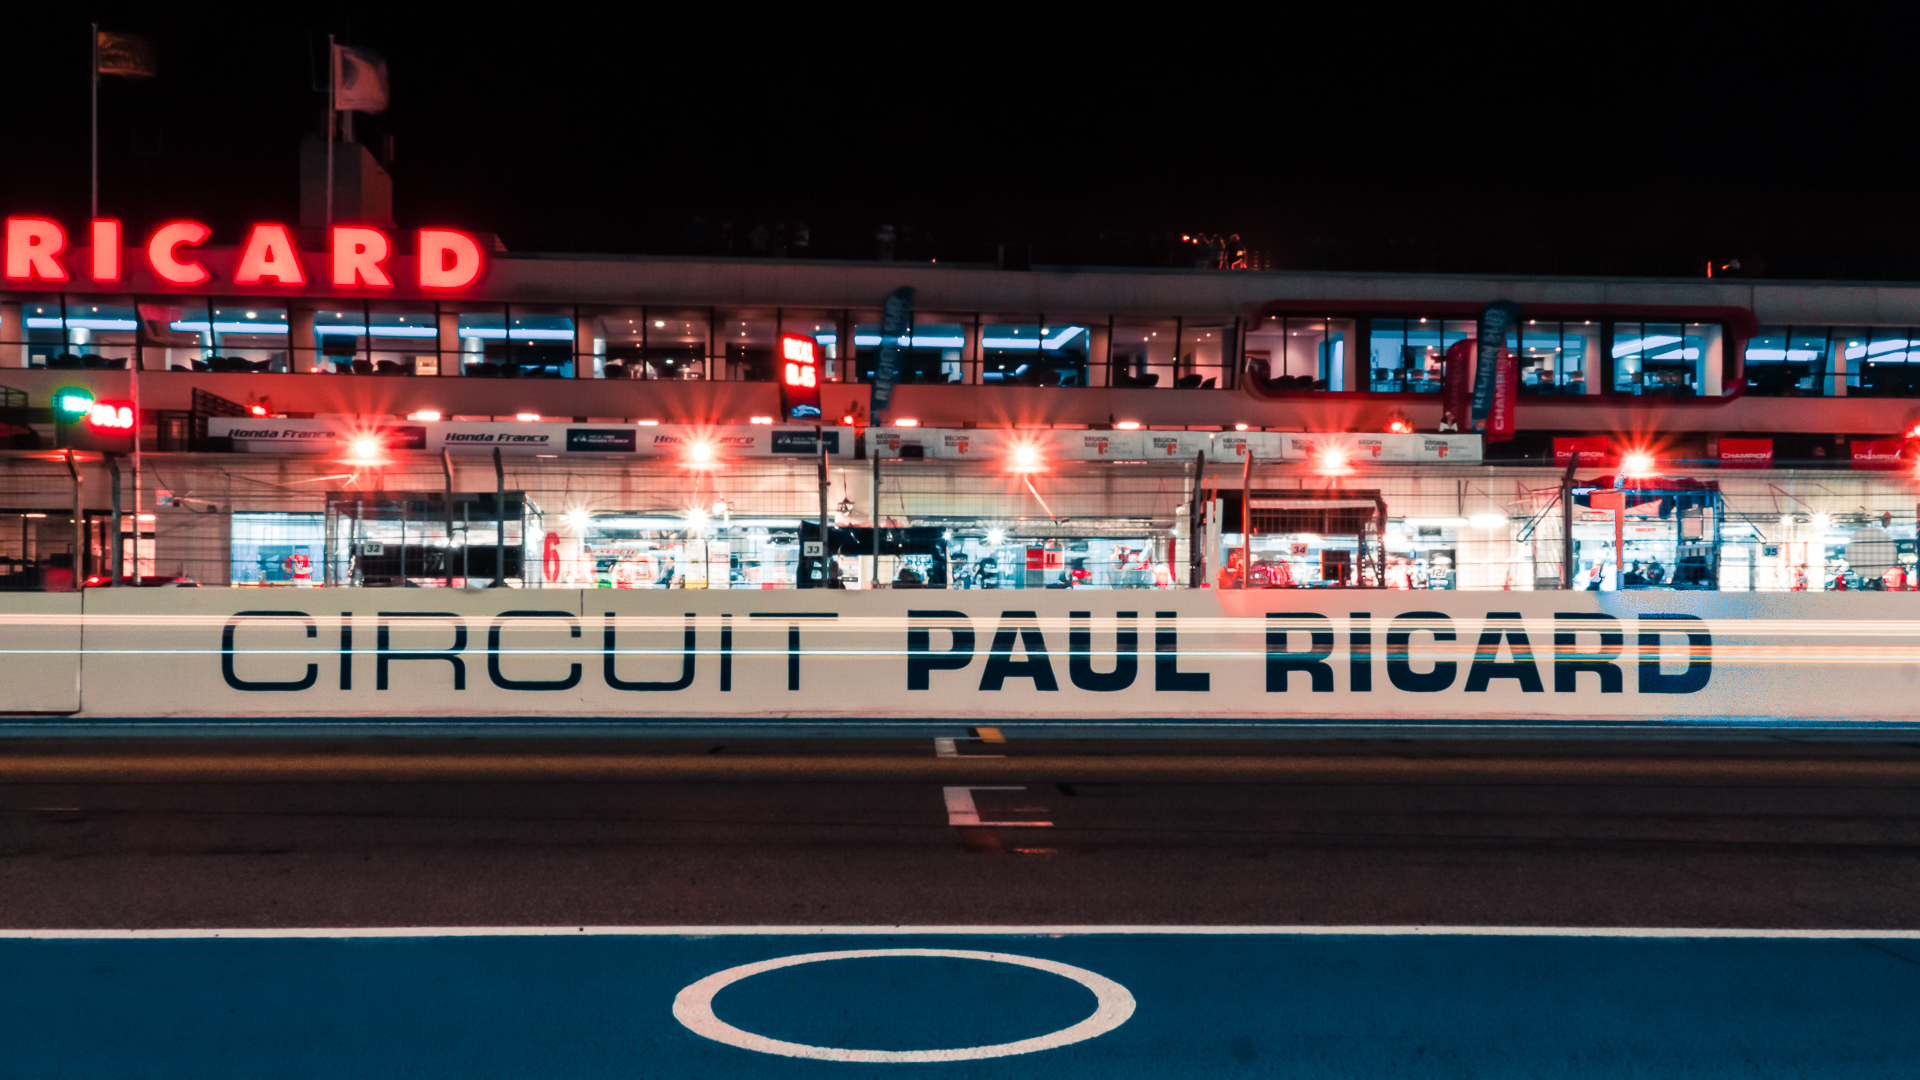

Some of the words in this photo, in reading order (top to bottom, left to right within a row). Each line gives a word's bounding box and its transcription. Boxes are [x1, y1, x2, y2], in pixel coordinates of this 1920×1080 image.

[6, 217, 482, 288] RICARD
[228, 429, 278, 438] Honda
[282, 429, 336, 439] France
[445, 433, 494, 441] Honda
[497, 433, 549, 442] France
[366, 544, 380, 553] 32
[1293, 546, 1306, 554] 34
[1764, 547, 1778, 556] 35
[543, 532, 560, 582] 6
[221, 610, 838, 692] CIRCUIT
[907, 610, 1210, 692] PAUL
[1265, 611, 1712, 694] RICARD
